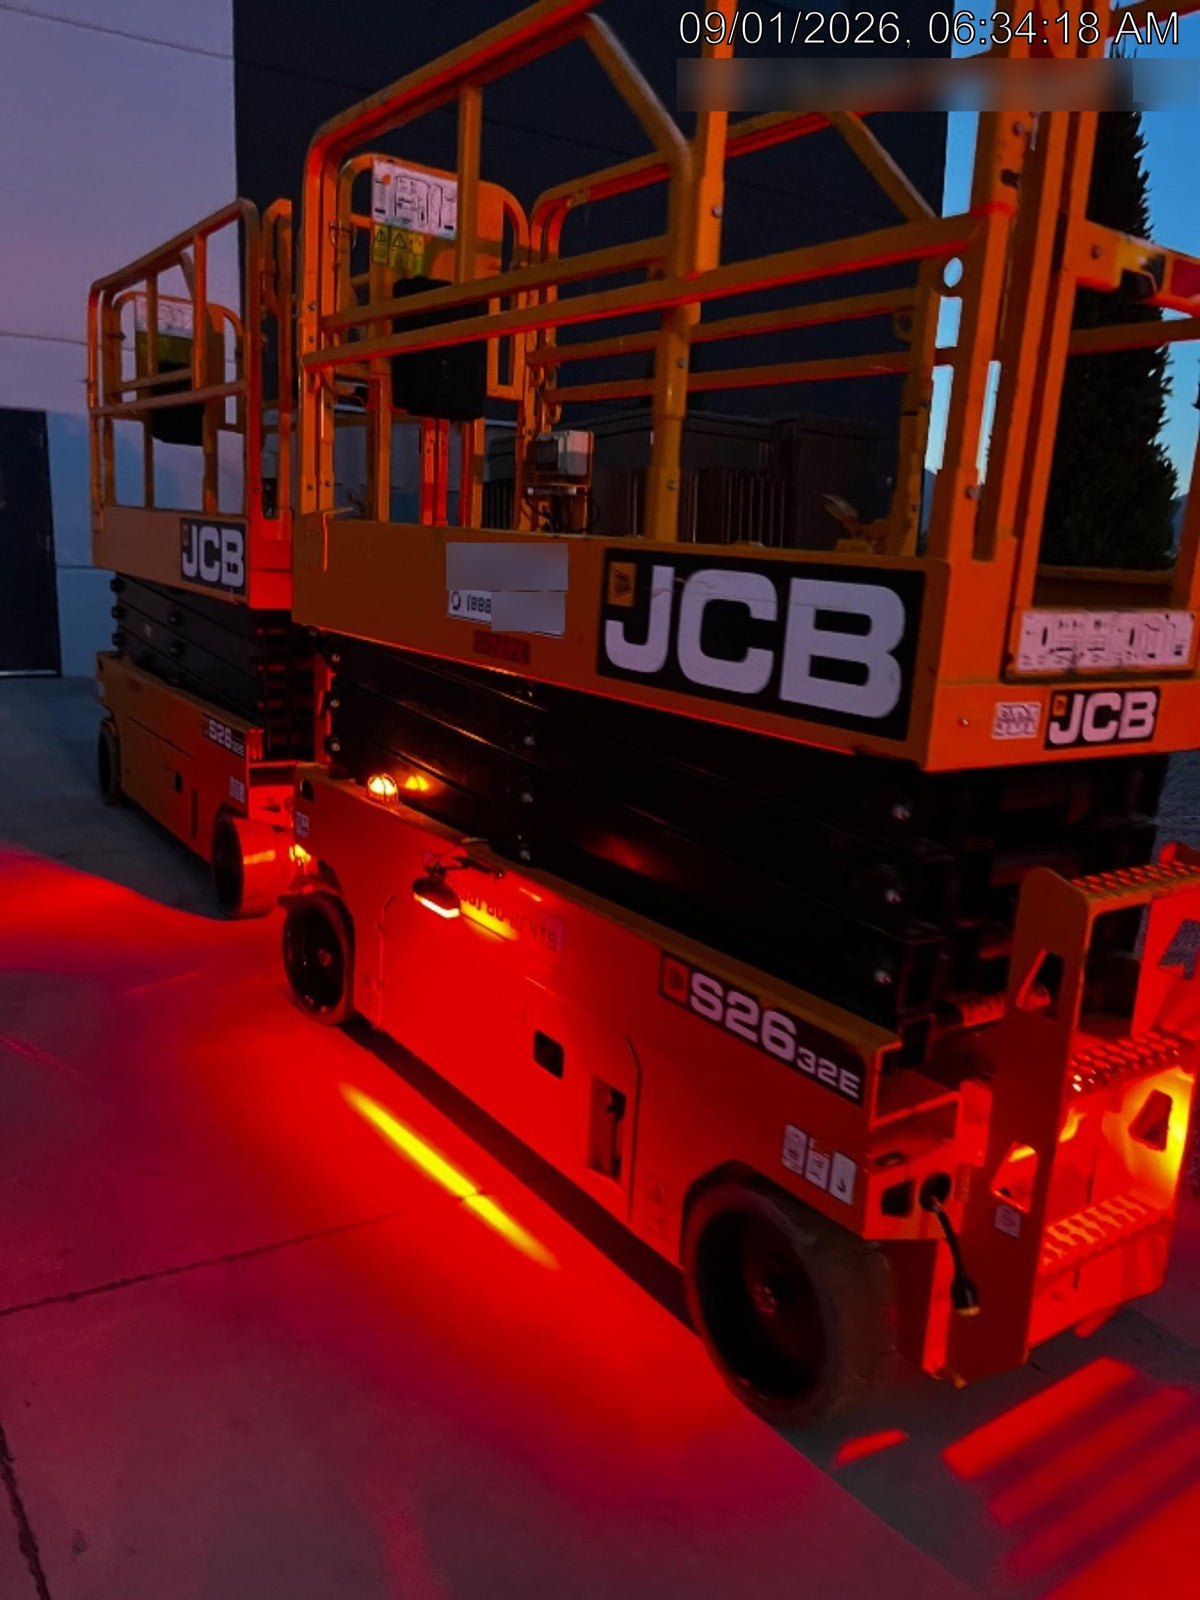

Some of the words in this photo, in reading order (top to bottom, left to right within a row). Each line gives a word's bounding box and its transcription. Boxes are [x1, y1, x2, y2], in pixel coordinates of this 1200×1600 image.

[182, 525, 244, 587] JCB
[605, 565, 906, 718] JCB
[1049, 691, 1157, 745] JCB
